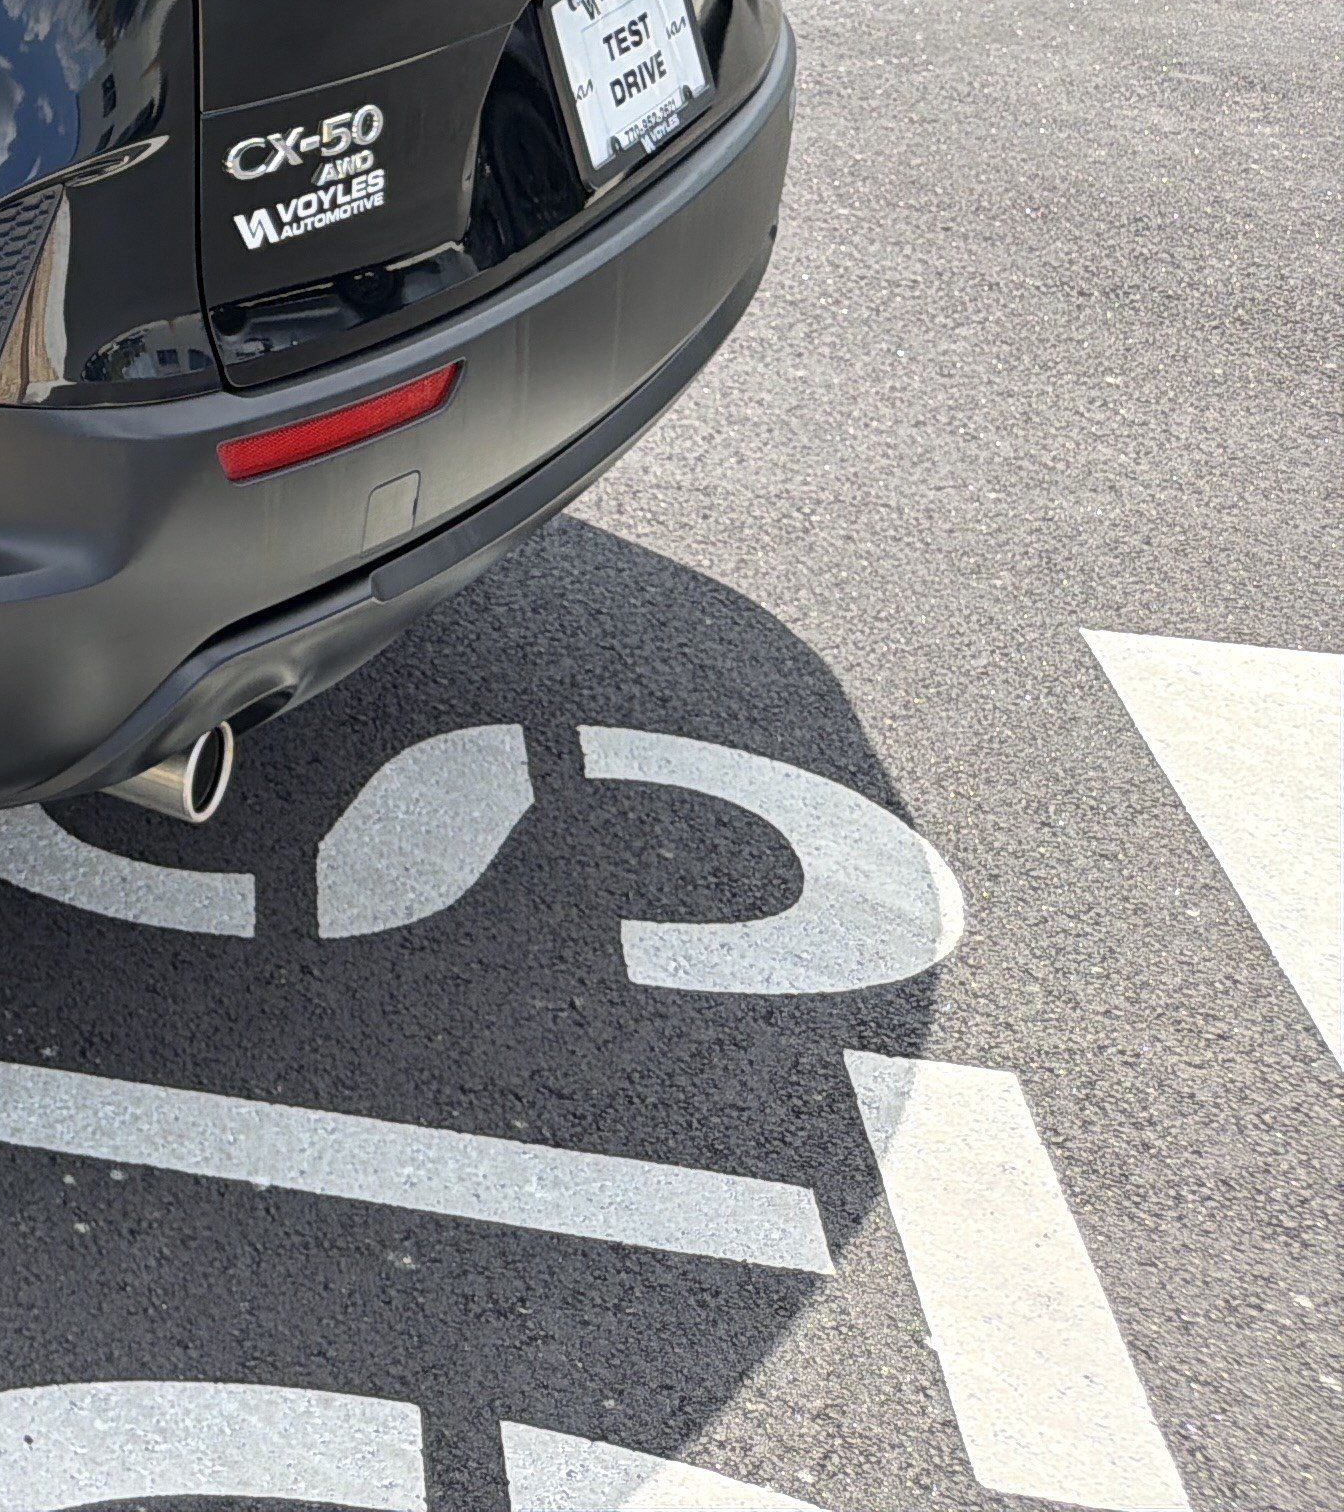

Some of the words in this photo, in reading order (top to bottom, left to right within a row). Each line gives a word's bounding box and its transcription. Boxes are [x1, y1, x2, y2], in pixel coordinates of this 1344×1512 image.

[603, 13, 651, 61] TEST
[610, 50, 667, 108] DRIVE
[224, 104, 384, 180] CX-50
[312, 150, 374, 186] AWD
[277, 169, 385, 223] VOYLES
[281, 192, 385, 239] AUTOMOTIVE
